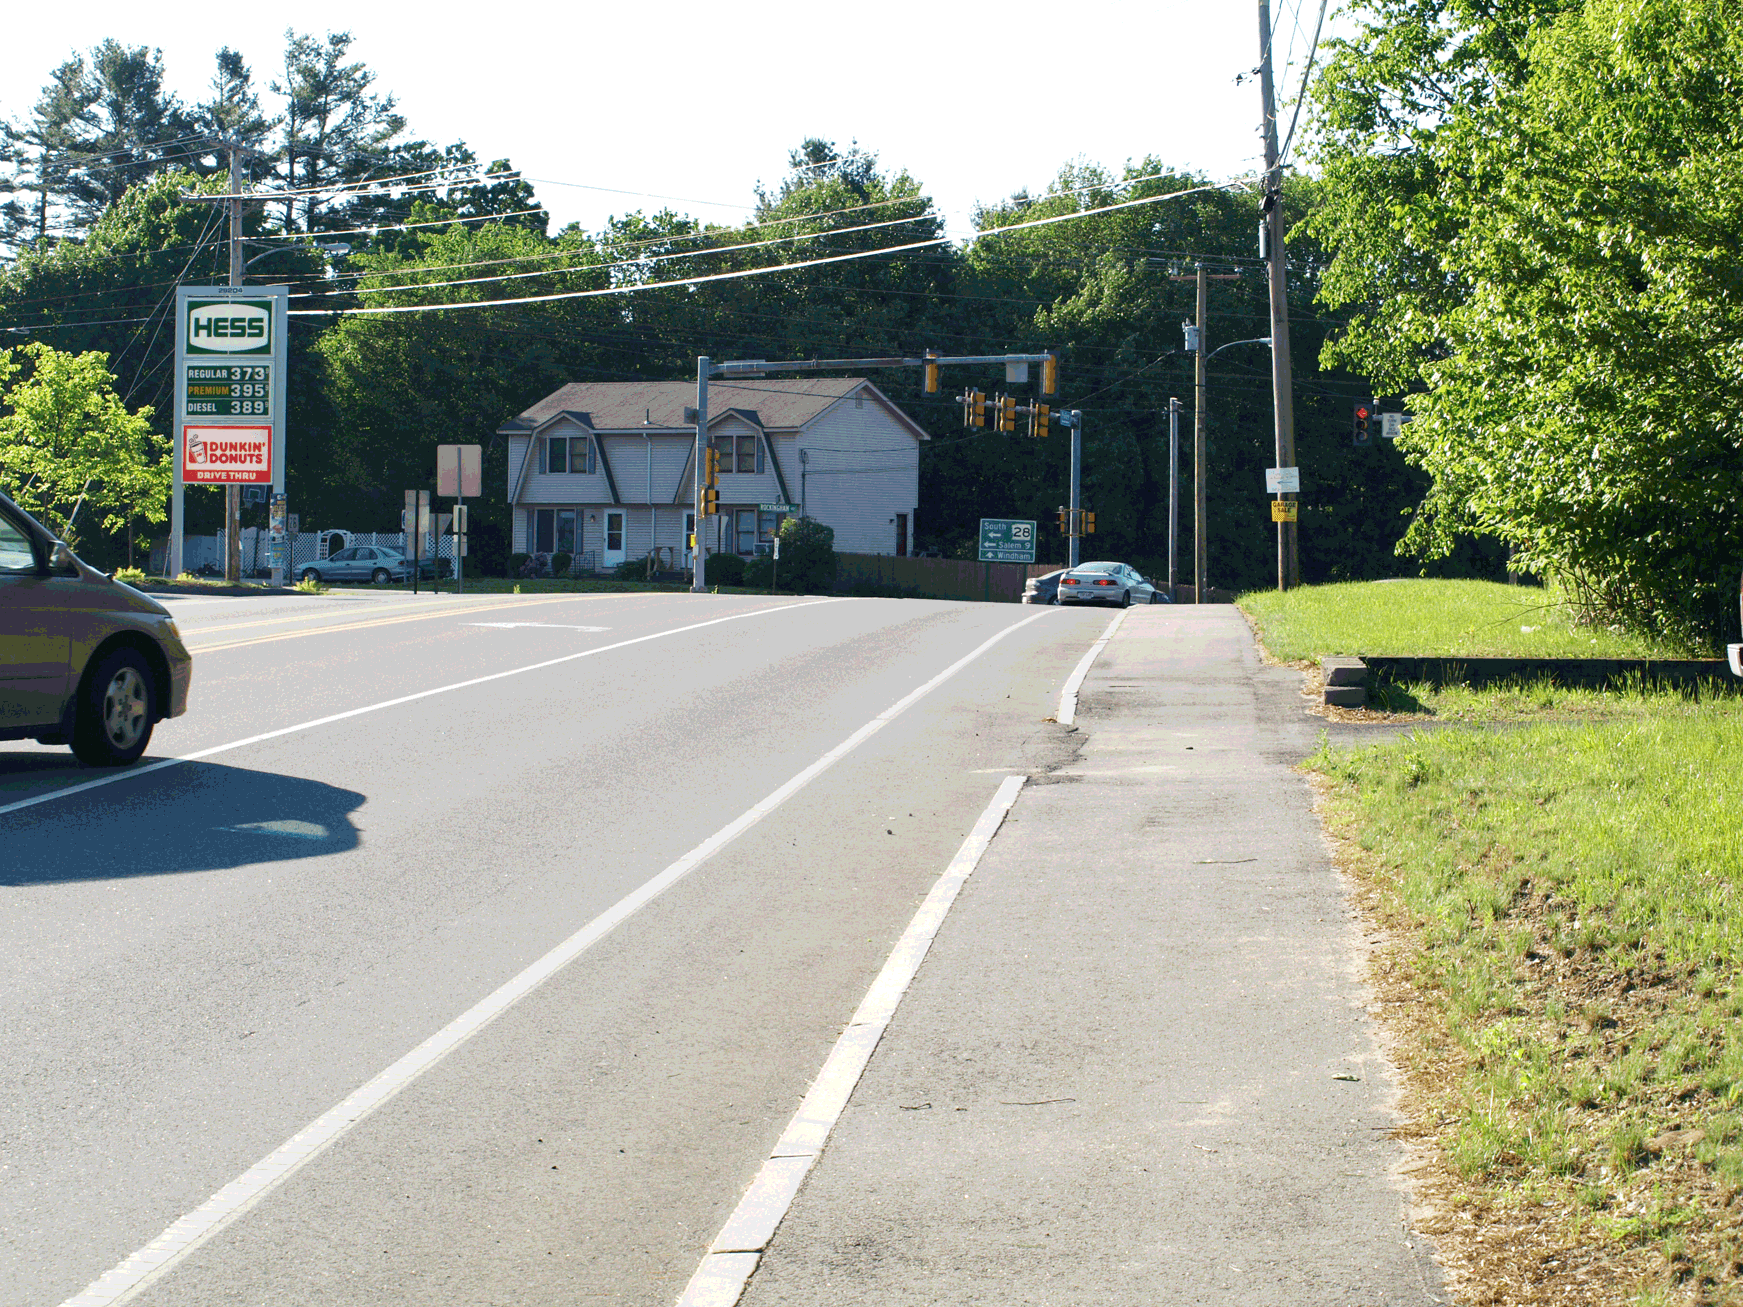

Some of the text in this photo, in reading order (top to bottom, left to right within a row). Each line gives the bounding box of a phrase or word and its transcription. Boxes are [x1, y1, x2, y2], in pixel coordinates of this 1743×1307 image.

[194, 317, 265, 338] HESS
[188, 369, 228, 379] REGULAR
[231, 367, 265, 381] 373
[188, 386, 230, 395] PREMIUM
[230, 384, 264, 397] 395
[188, 402, 217, 412] DIESEL
[230, 401, 264, 414] 389
[209, 441, 265, 453] DUNKIN'
[209, 453, 263, 464] DONUTS
[197, 471, 256, 480] DRIVE THRU
[1014, 527, 1030, 538] 28
